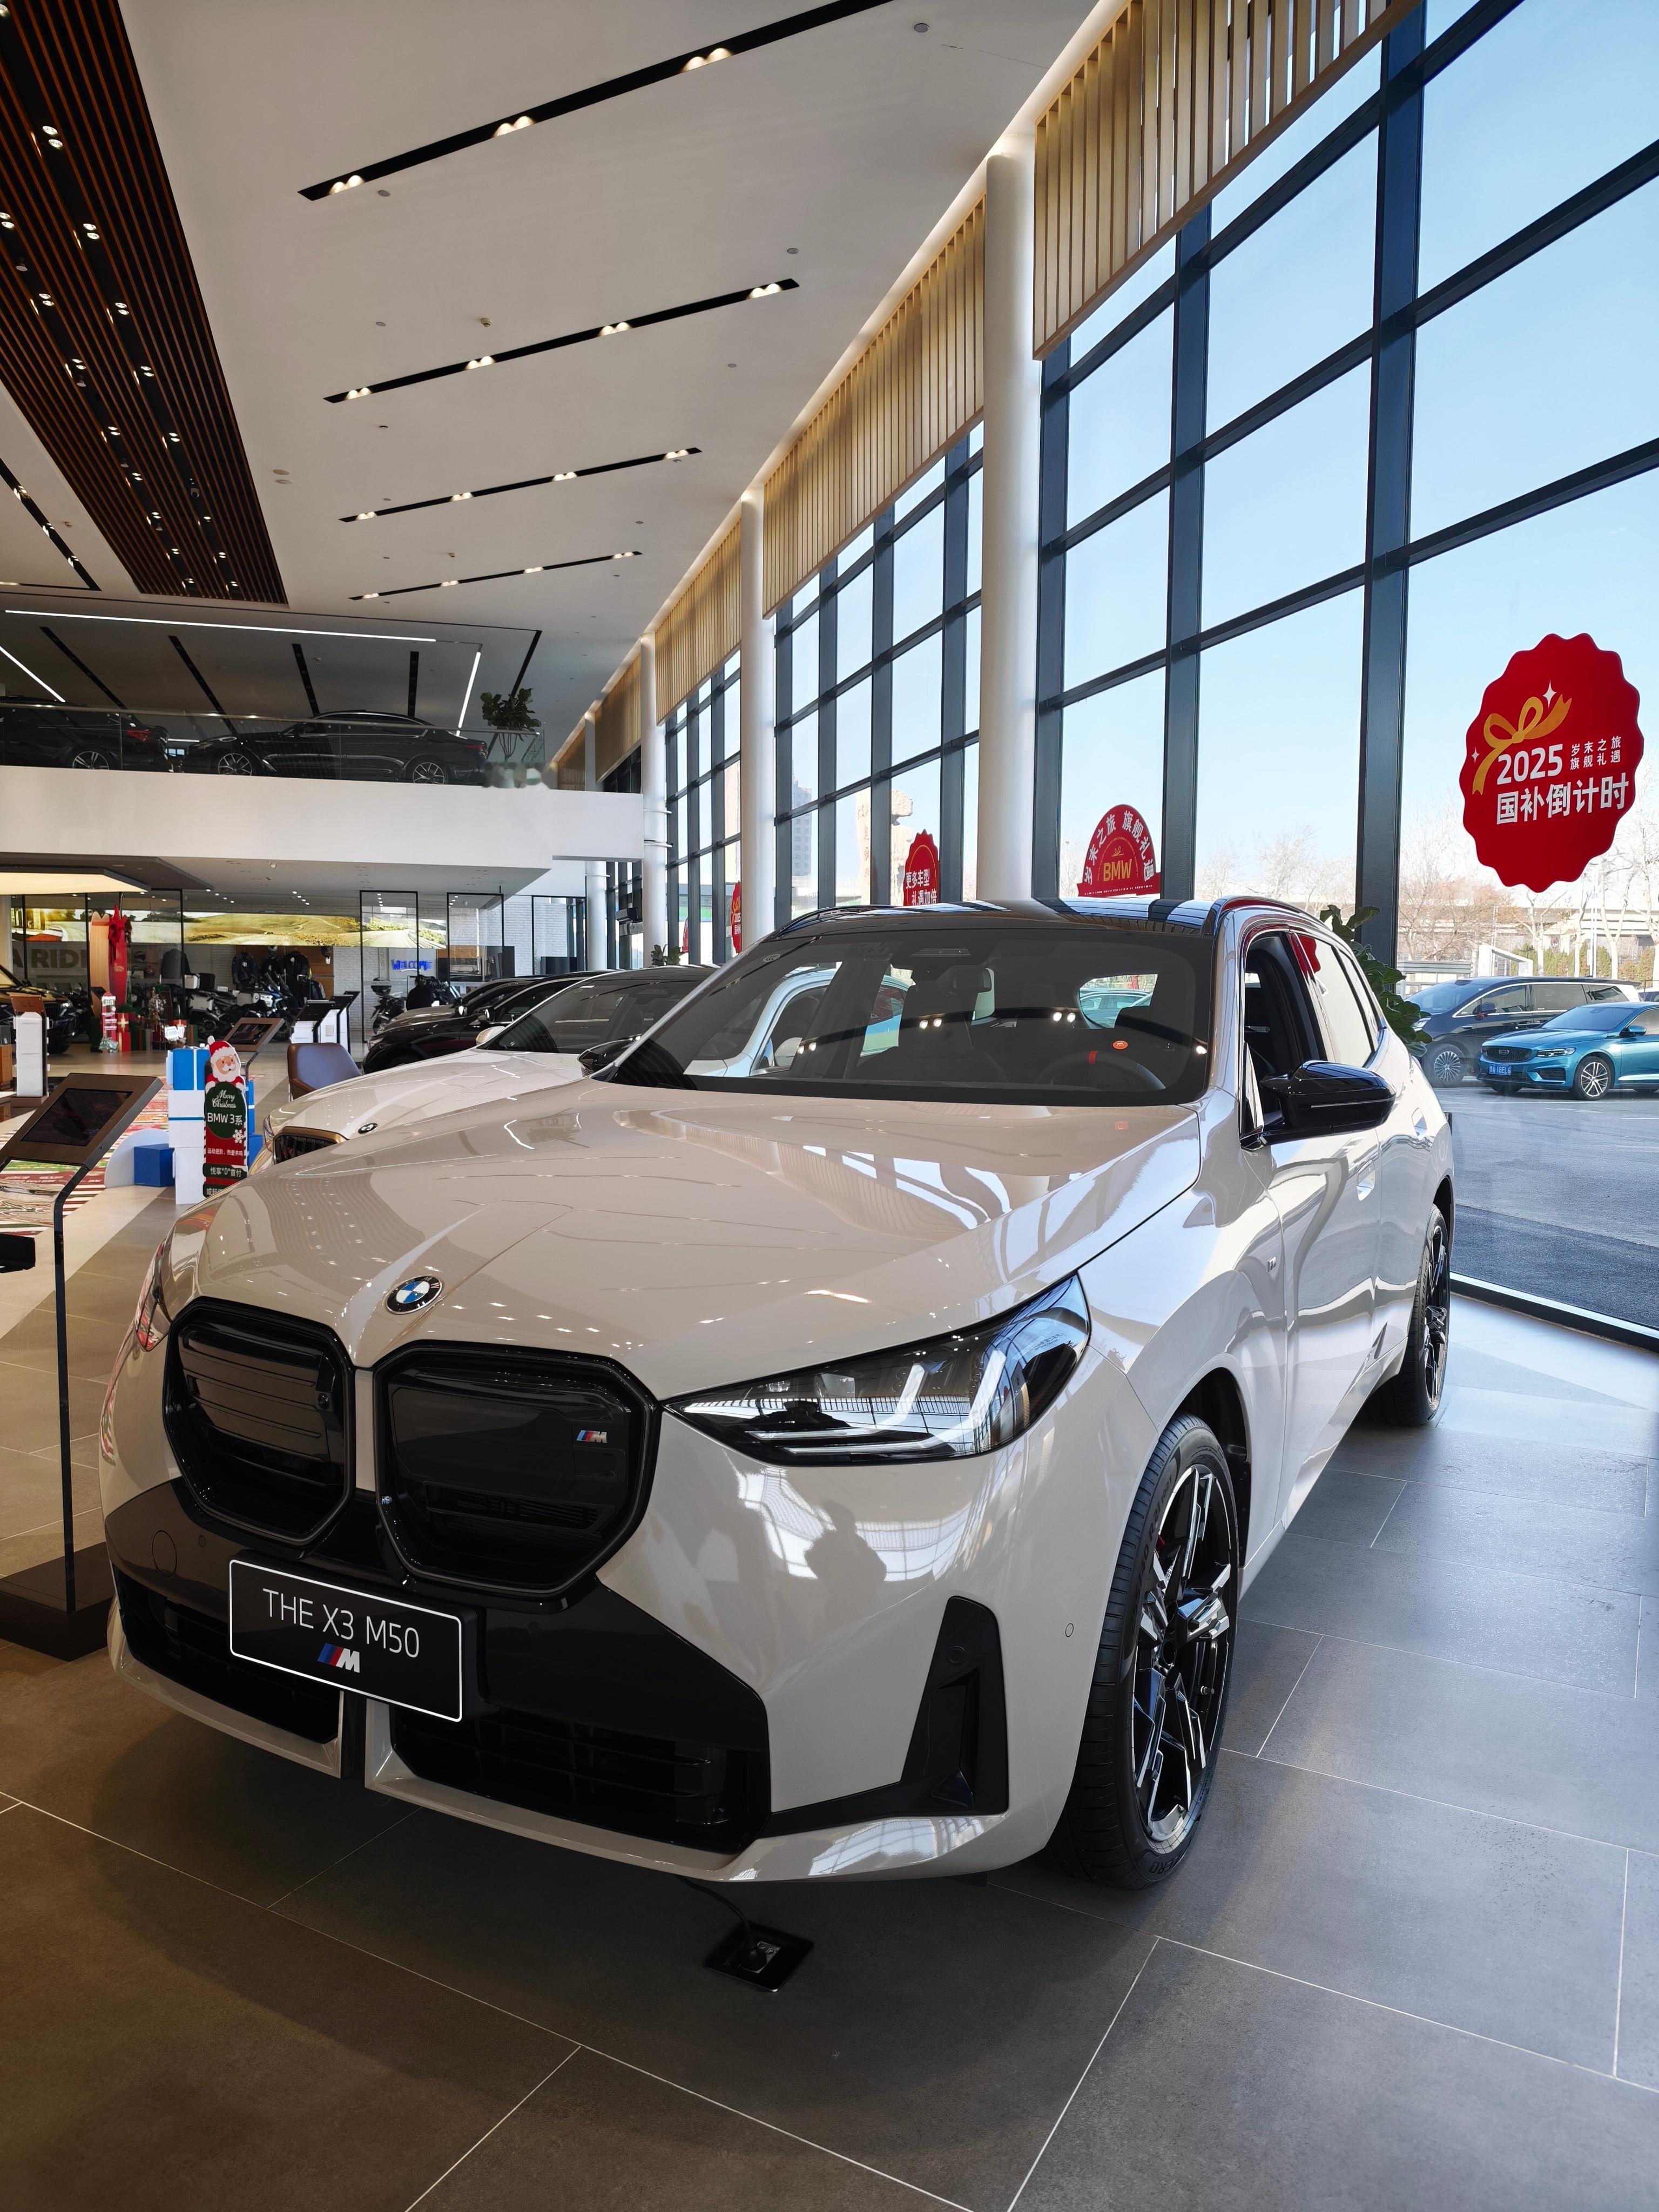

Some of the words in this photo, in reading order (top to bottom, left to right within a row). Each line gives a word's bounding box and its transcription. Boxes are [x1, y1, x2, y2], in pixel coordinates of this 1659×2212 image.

[1571, 736, 1621, 757] 岁末之旅
[1497, 744, 1563, 785] 2025
[1570, 750, 1621, 770] 旗舰礼遇
[1497, 772, 1629, 825] 国补倒计时
[1084, 814, 1116, 885] 岁末之旅
[1122, 810, 1155, 882] 旗舰礼遇
[906, 868, 930, 889] 更多车型
[1103, 859, 1132, 882] BMW
[912, 888, 937, 906] 礼遇加倍
[31, 949, 87, 968] RID
[212, 1098, 237, 1108] Christmas
[217, 1090, 235, 1102] Merry
[207, 1112, 228, 1123] BMW
[230, 1114, 242, 1125] 3系
[263, 1588, 314, 1629] THE
[322, 1604, 354, 1640] X3
[366, 1616, 419, 1658] M50
